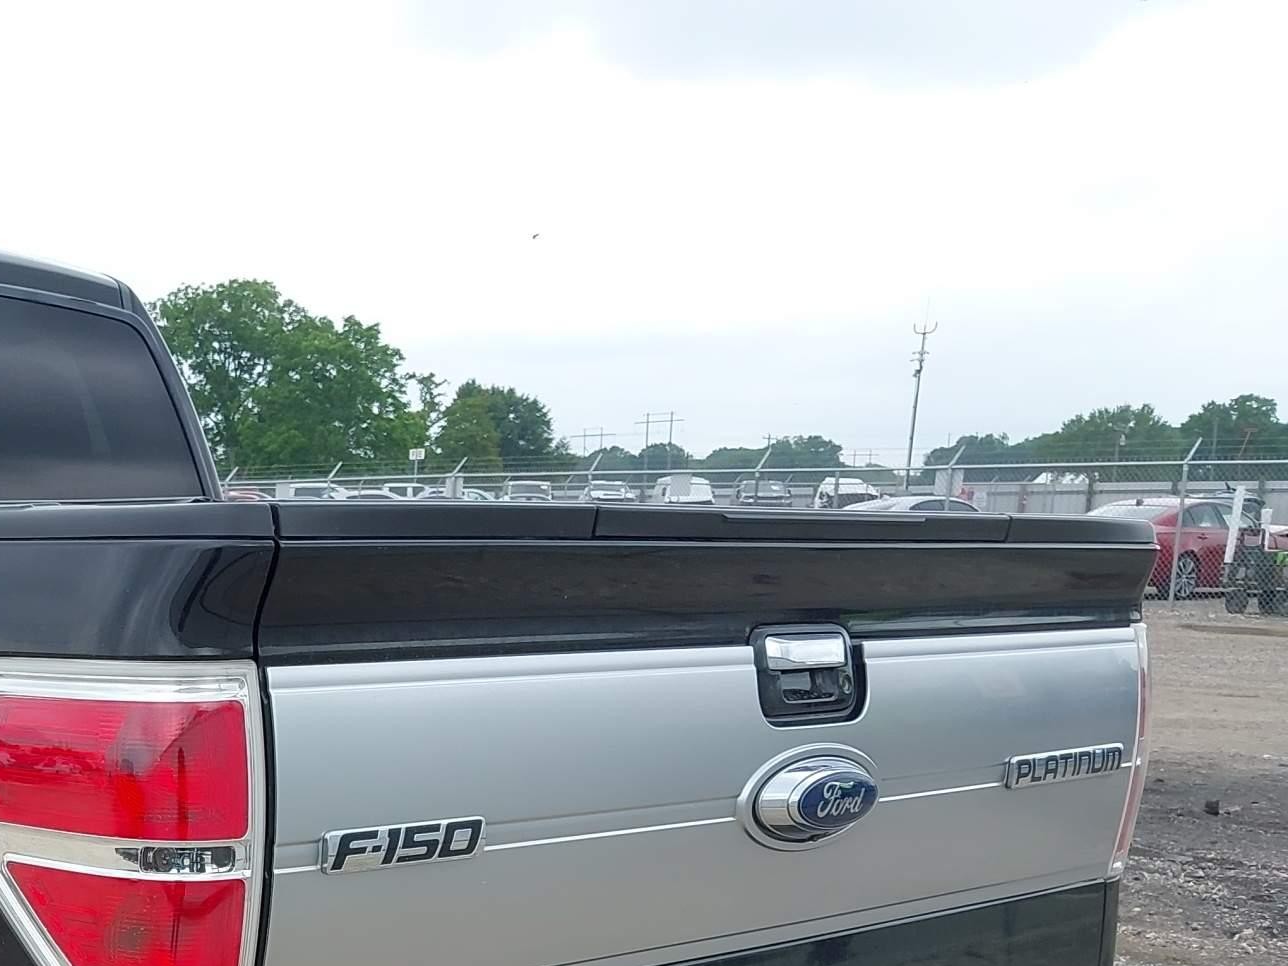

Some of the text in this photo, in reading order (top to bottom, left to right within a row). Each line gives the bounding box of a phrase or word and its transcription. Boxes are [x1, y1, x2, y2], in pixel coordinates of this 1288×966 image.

[1015, 746, 1122, 785] PLATINUM
[817, 781, 866, 818] Ford
[330, 818, 484, 871] F-150
